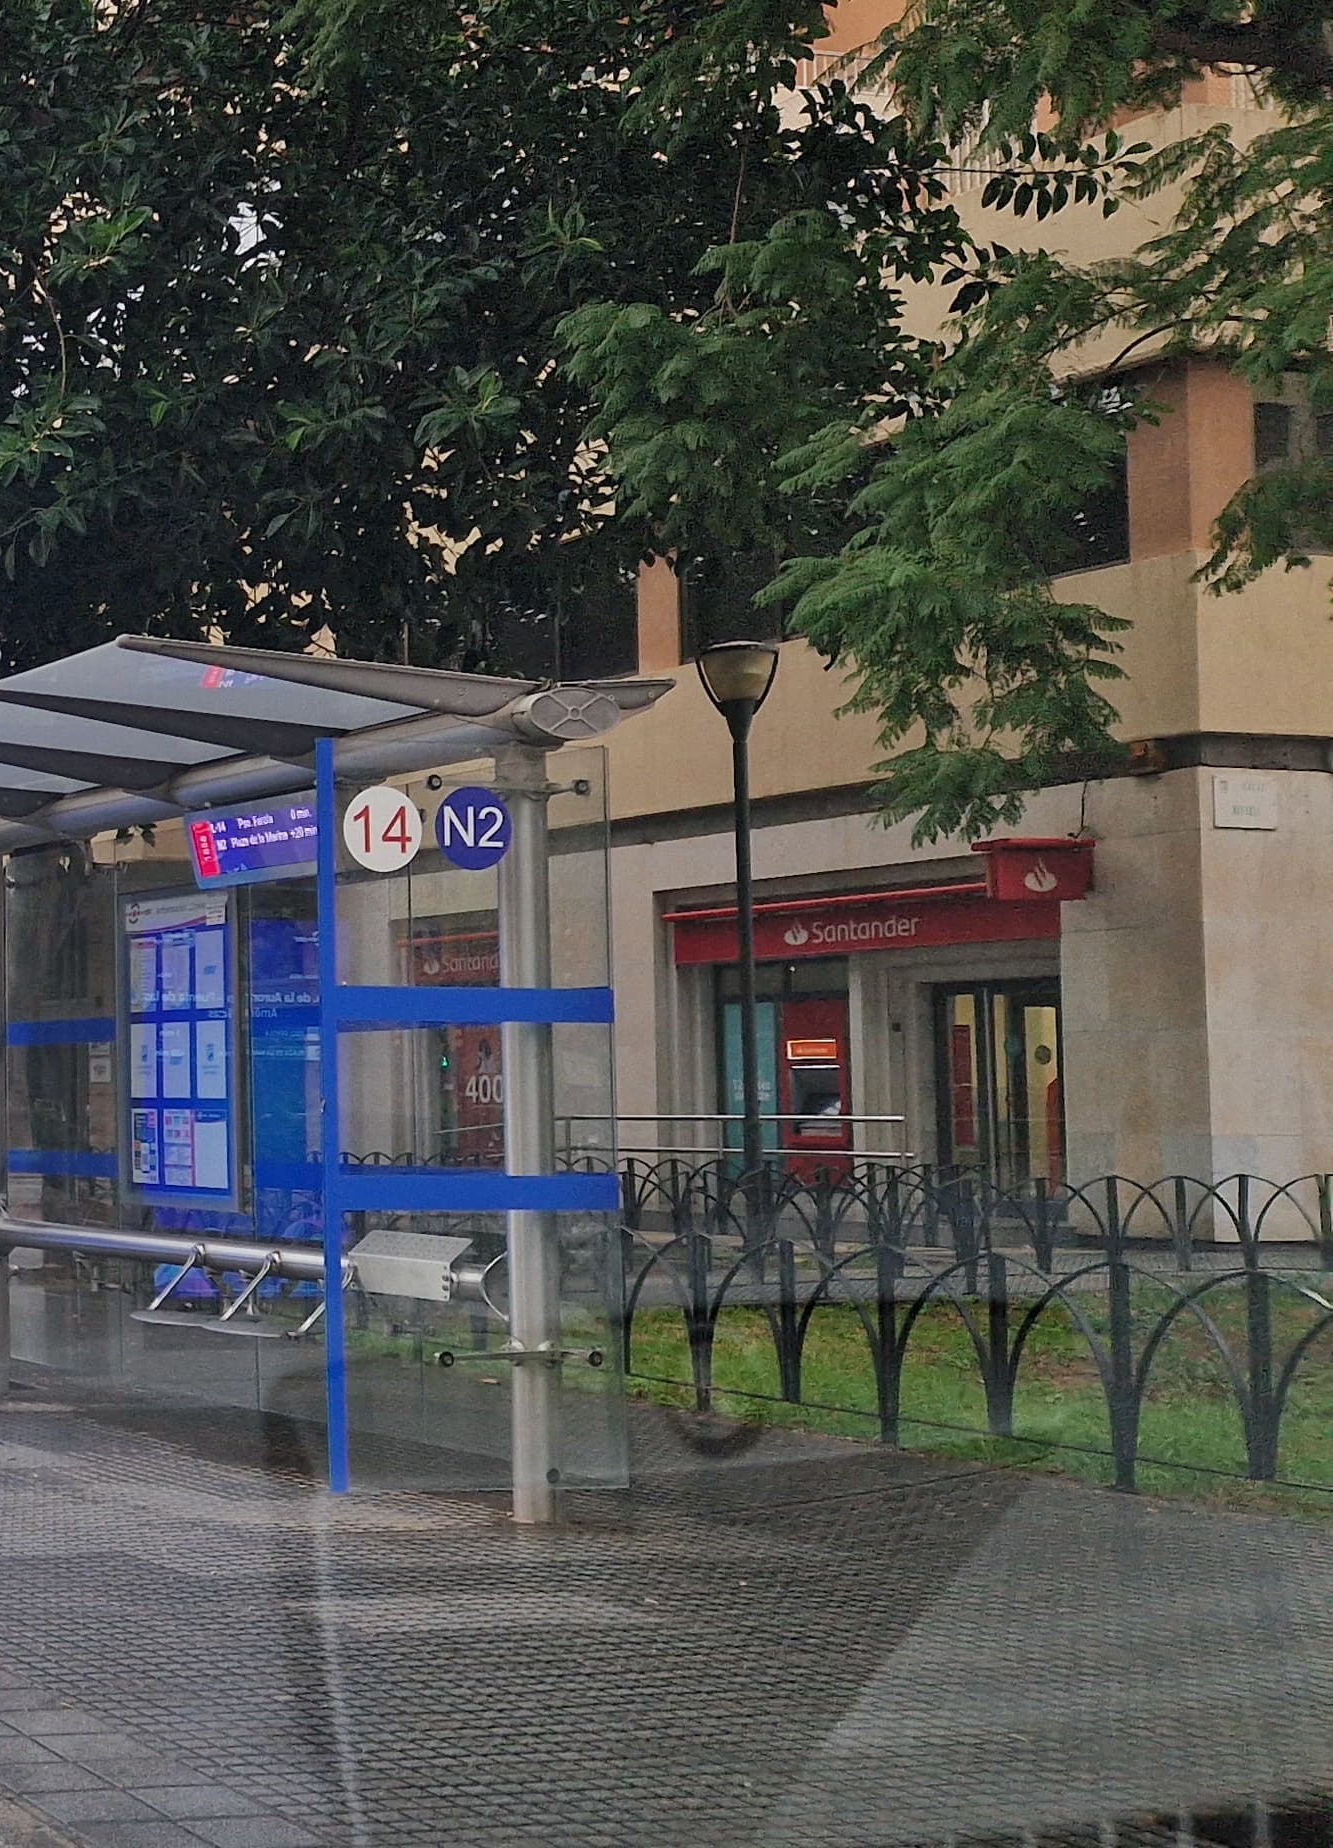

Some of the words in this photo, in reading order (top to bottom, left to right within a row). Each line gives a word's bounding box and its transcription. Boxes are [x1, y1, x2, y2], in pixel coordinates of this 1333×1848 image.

[231, 835, 250, 848] Plaza
[353, 805, 412, 853] 14
[443, 806, 504, 847] N2
[811, 916, 919, 944] Santander
